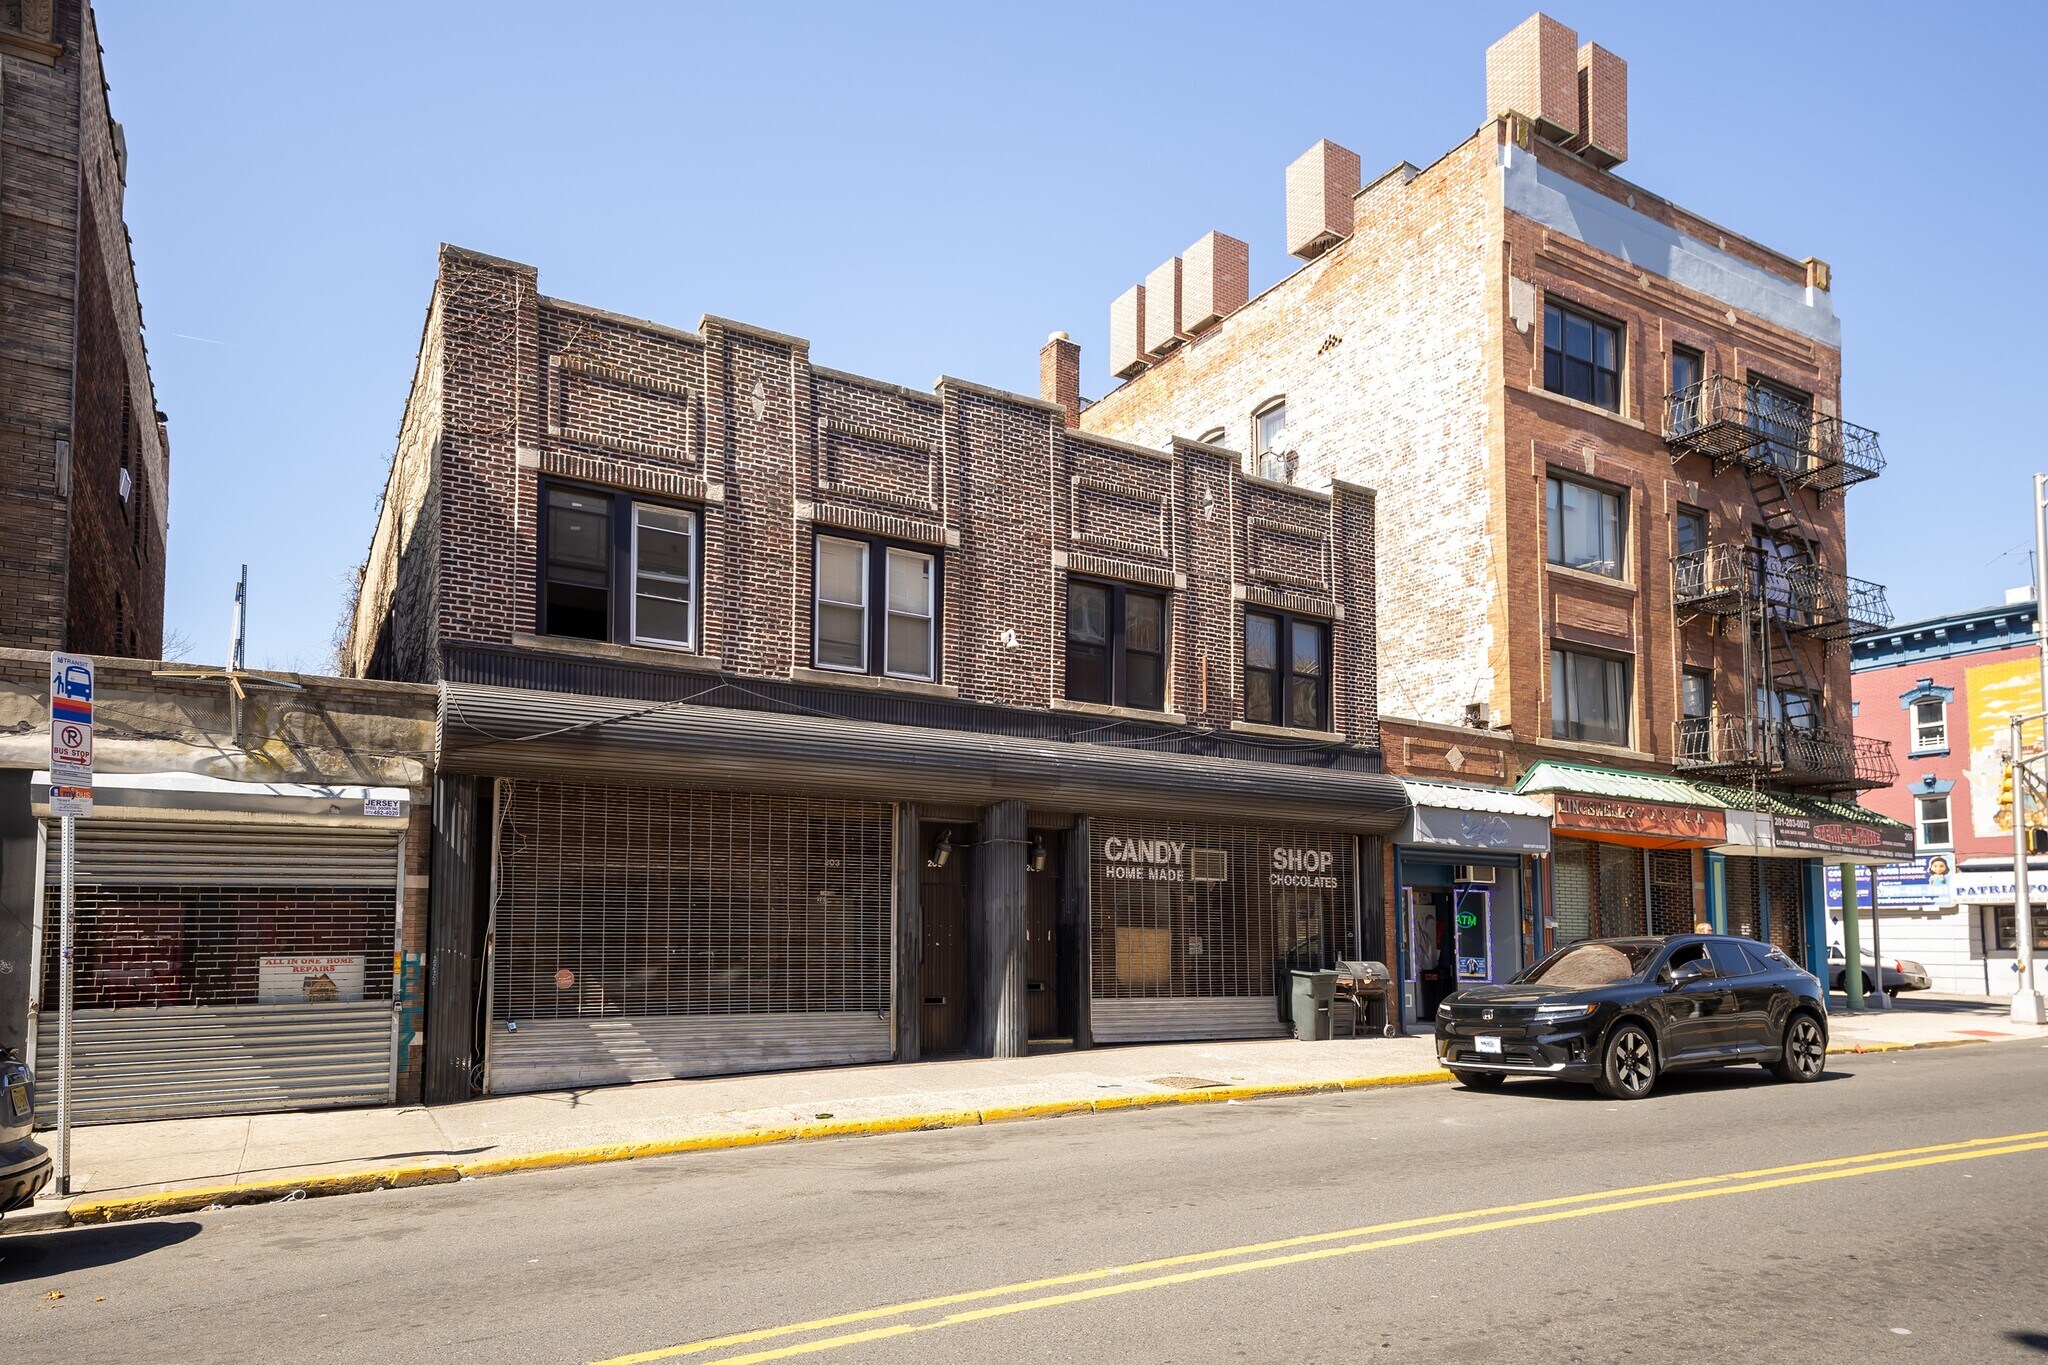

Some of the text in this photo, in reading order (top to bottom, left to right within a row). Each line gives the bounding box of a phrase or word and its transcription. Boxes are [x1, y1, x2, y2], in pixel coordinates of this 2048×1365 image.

[64, 658, 88, 667] TRANSIT
[54, 747, 89, 758] BUS STOP
[1104, 837, 1333, 872] CANDY SHOP
[1105, 865, 1337, 888] HOME MADE CHOCOLATES
[1456, 915, 1477, 926] ATM
